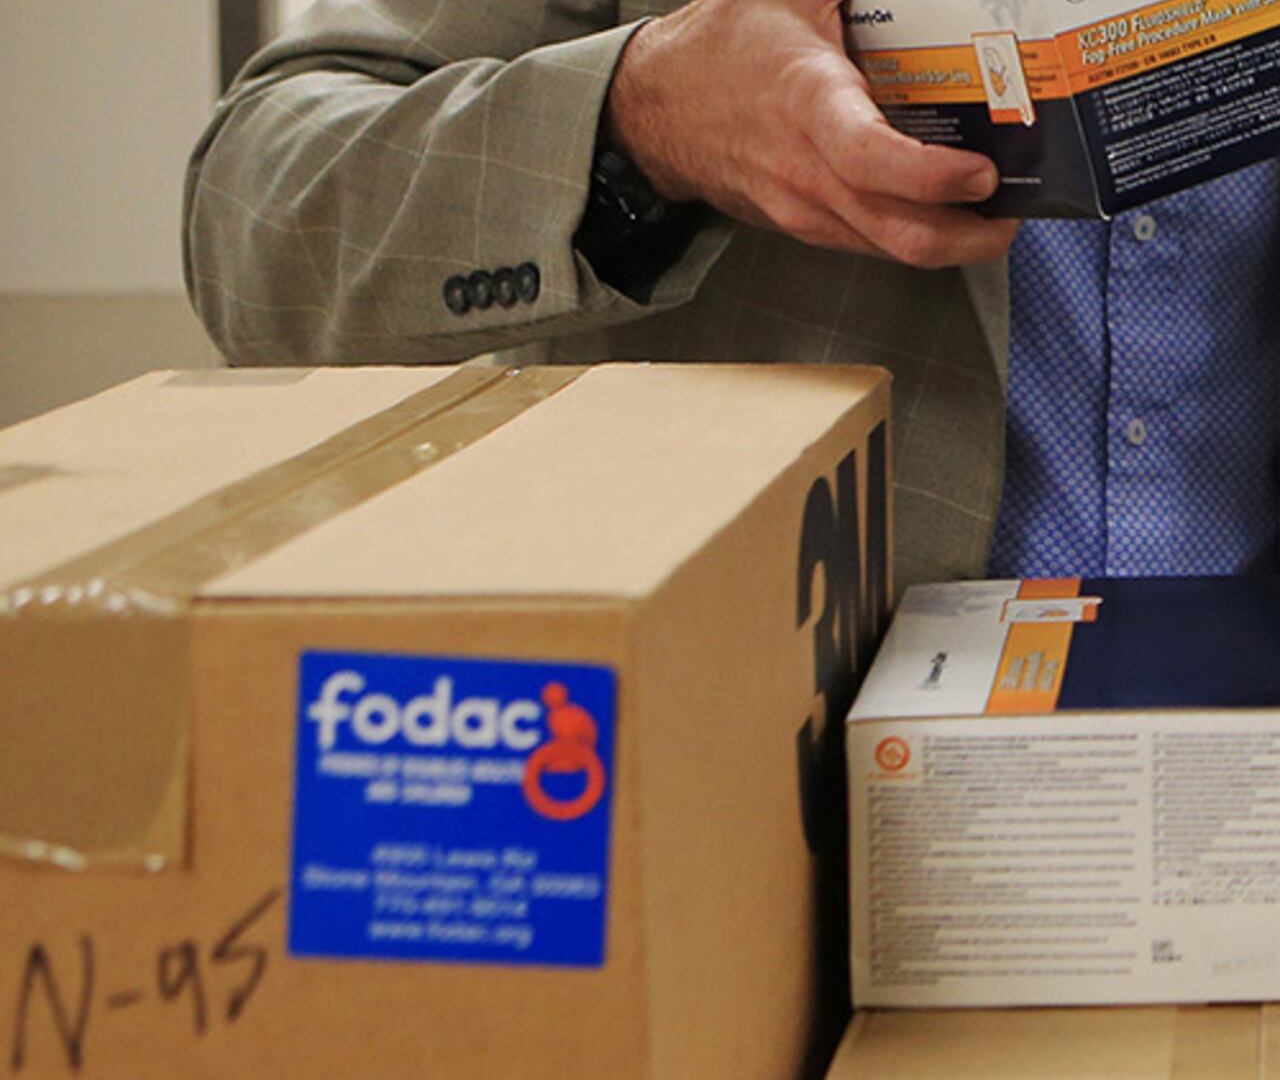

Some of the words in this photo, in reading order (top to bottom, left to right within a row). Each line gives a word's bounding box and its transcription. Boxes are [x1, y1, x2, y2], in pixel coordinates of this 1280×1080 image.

[1078, 20, 1127, 50] KC300
[1082, 38, 1135, 65] Fog-Free
[1137, 18, 1199, 46] Procedure
[1200, 9, 1232, 30] Mask
[307, 669, 542, 751] fodac
[11, 886, 282, 1074] N-95
